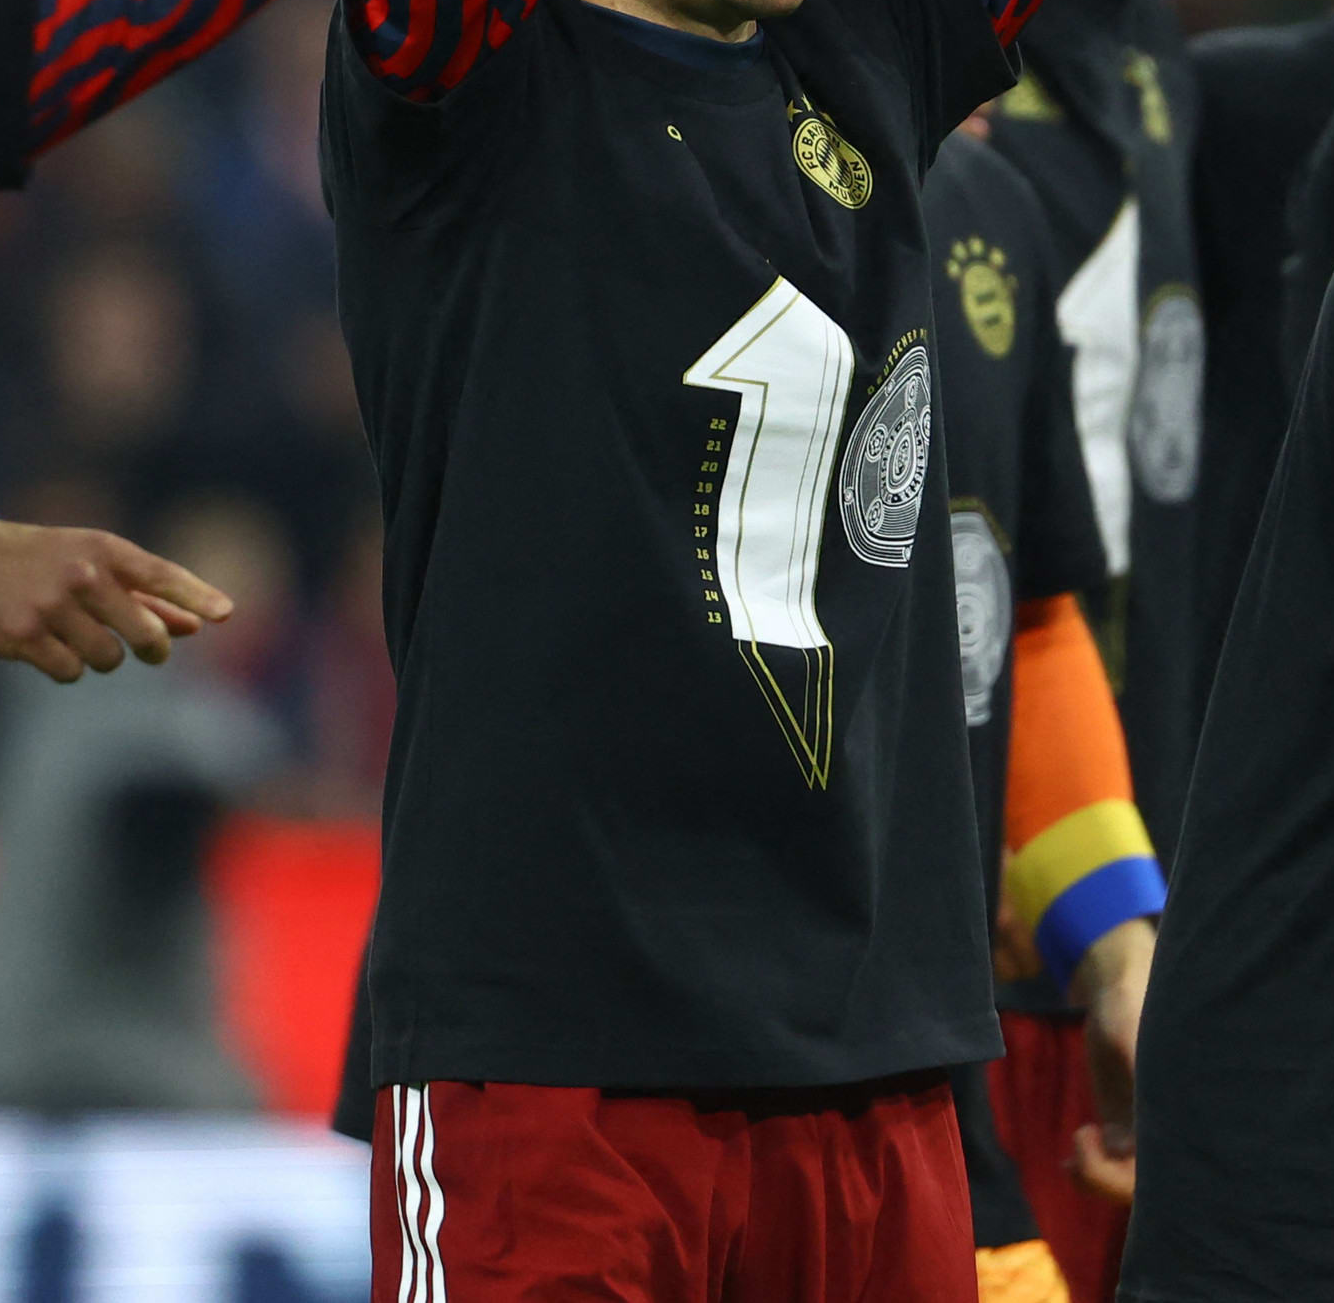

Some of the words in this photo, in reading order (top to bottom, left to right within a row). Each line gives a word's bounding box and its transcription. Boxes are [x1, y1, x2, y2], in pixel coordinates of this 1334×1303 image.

[802, 151, 818, 169] FC
[710, 418, 727, 430] 22
[706, 440, 721, 451] 21
[701, 461, 718, 472] 20
[696, 482, 713, 493] 19
[694, 504, 710, 515] 18
[694, 526, 707, 538] 17
[696, 548, 709, 560] 16
[701, 569, 714, 581] 15
[705, 589, 719, 602] 14
[707, 612, 722, 624] 13
